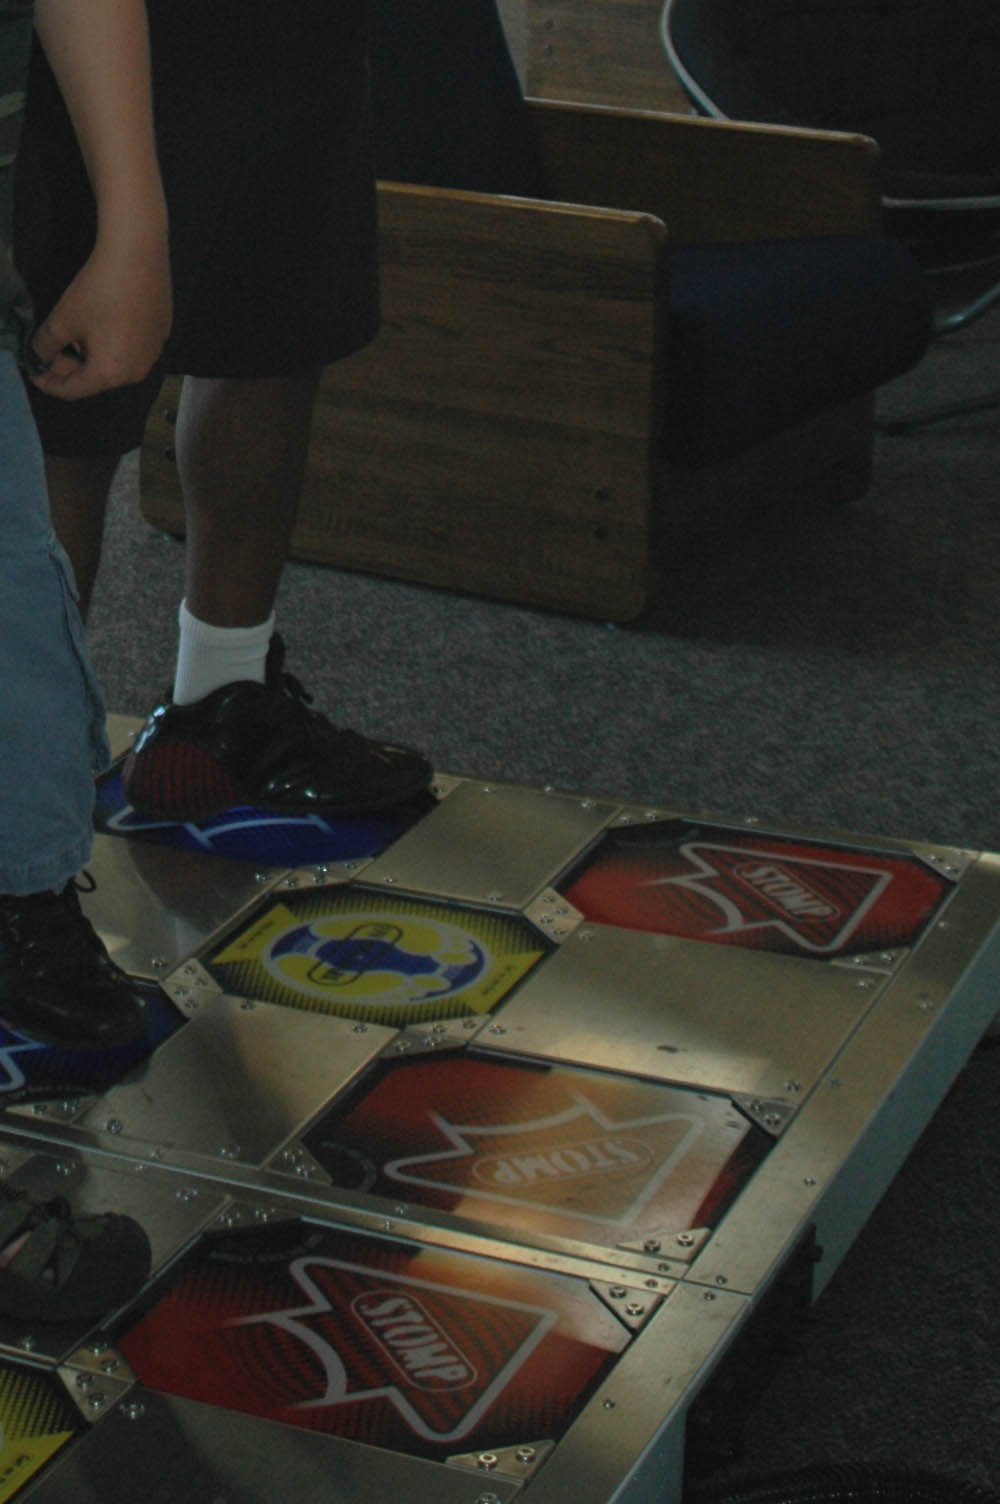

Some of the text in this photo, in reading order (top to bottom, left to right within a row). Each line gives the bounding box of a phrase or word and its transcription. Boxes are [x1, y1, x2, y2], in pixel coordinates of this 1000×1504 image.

[740, 865, 835, 917] STOMP
[493, 1139, 641, 1185] STOMP
[358, 1297, 469, 1382] STOMP
